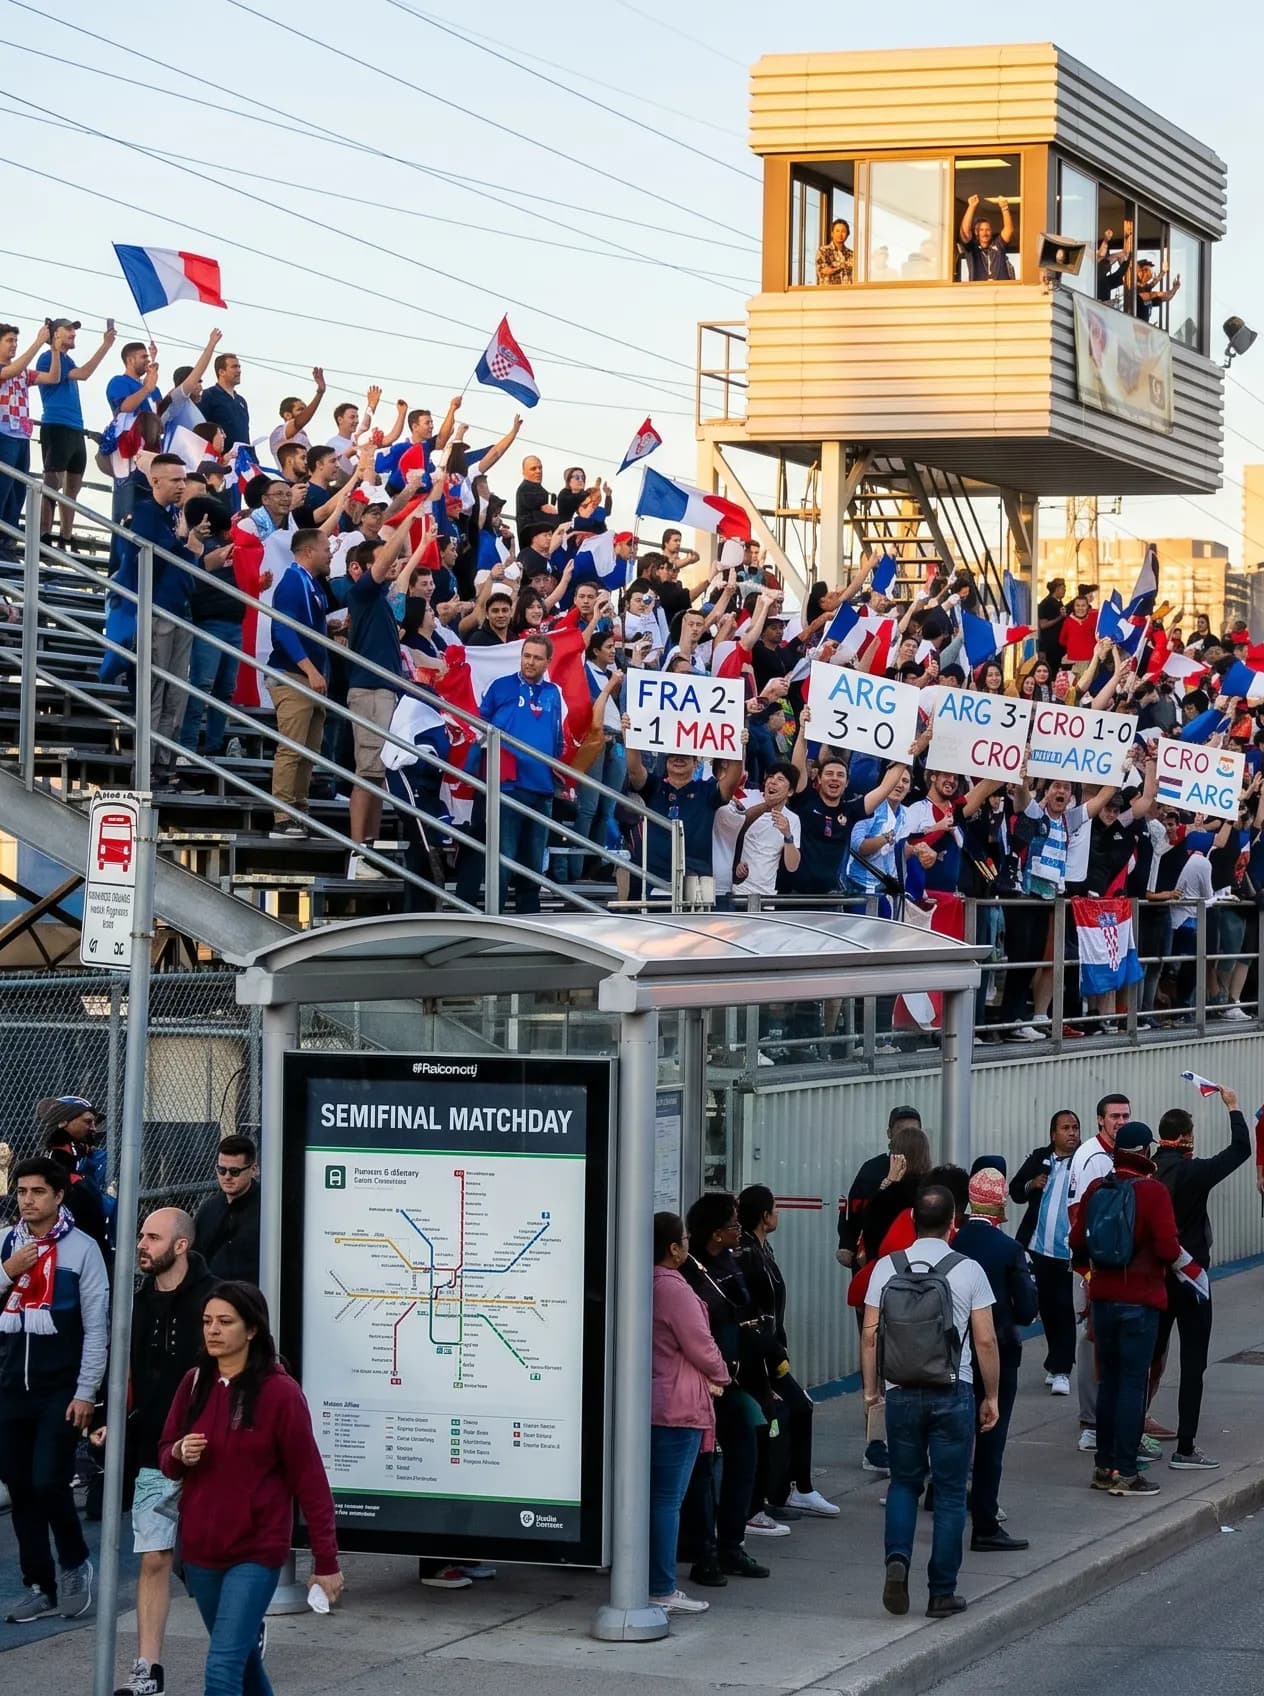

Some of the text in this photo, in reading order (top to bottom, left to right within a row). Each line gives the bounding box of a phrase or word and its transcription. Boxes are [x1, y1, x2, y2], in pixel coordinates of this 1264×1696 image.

[638, 680, 701, 713] FRA
[828, 673, 897, 714] ARG
[938, 692, 992, 726] ARG
[676, 720, 736, 752] MAR
[1036, 711, 1133, 744] CRO 1-0
[970, 739, 1021, 772] CRO
[1061, 747, 1113, 775] ARG
[1163, 745, 1210, 775] CRO
[1186, 781, 1234, 810] ARG
[320, 1102, 573, 1134] SEMIFINAL MATCHDAY
